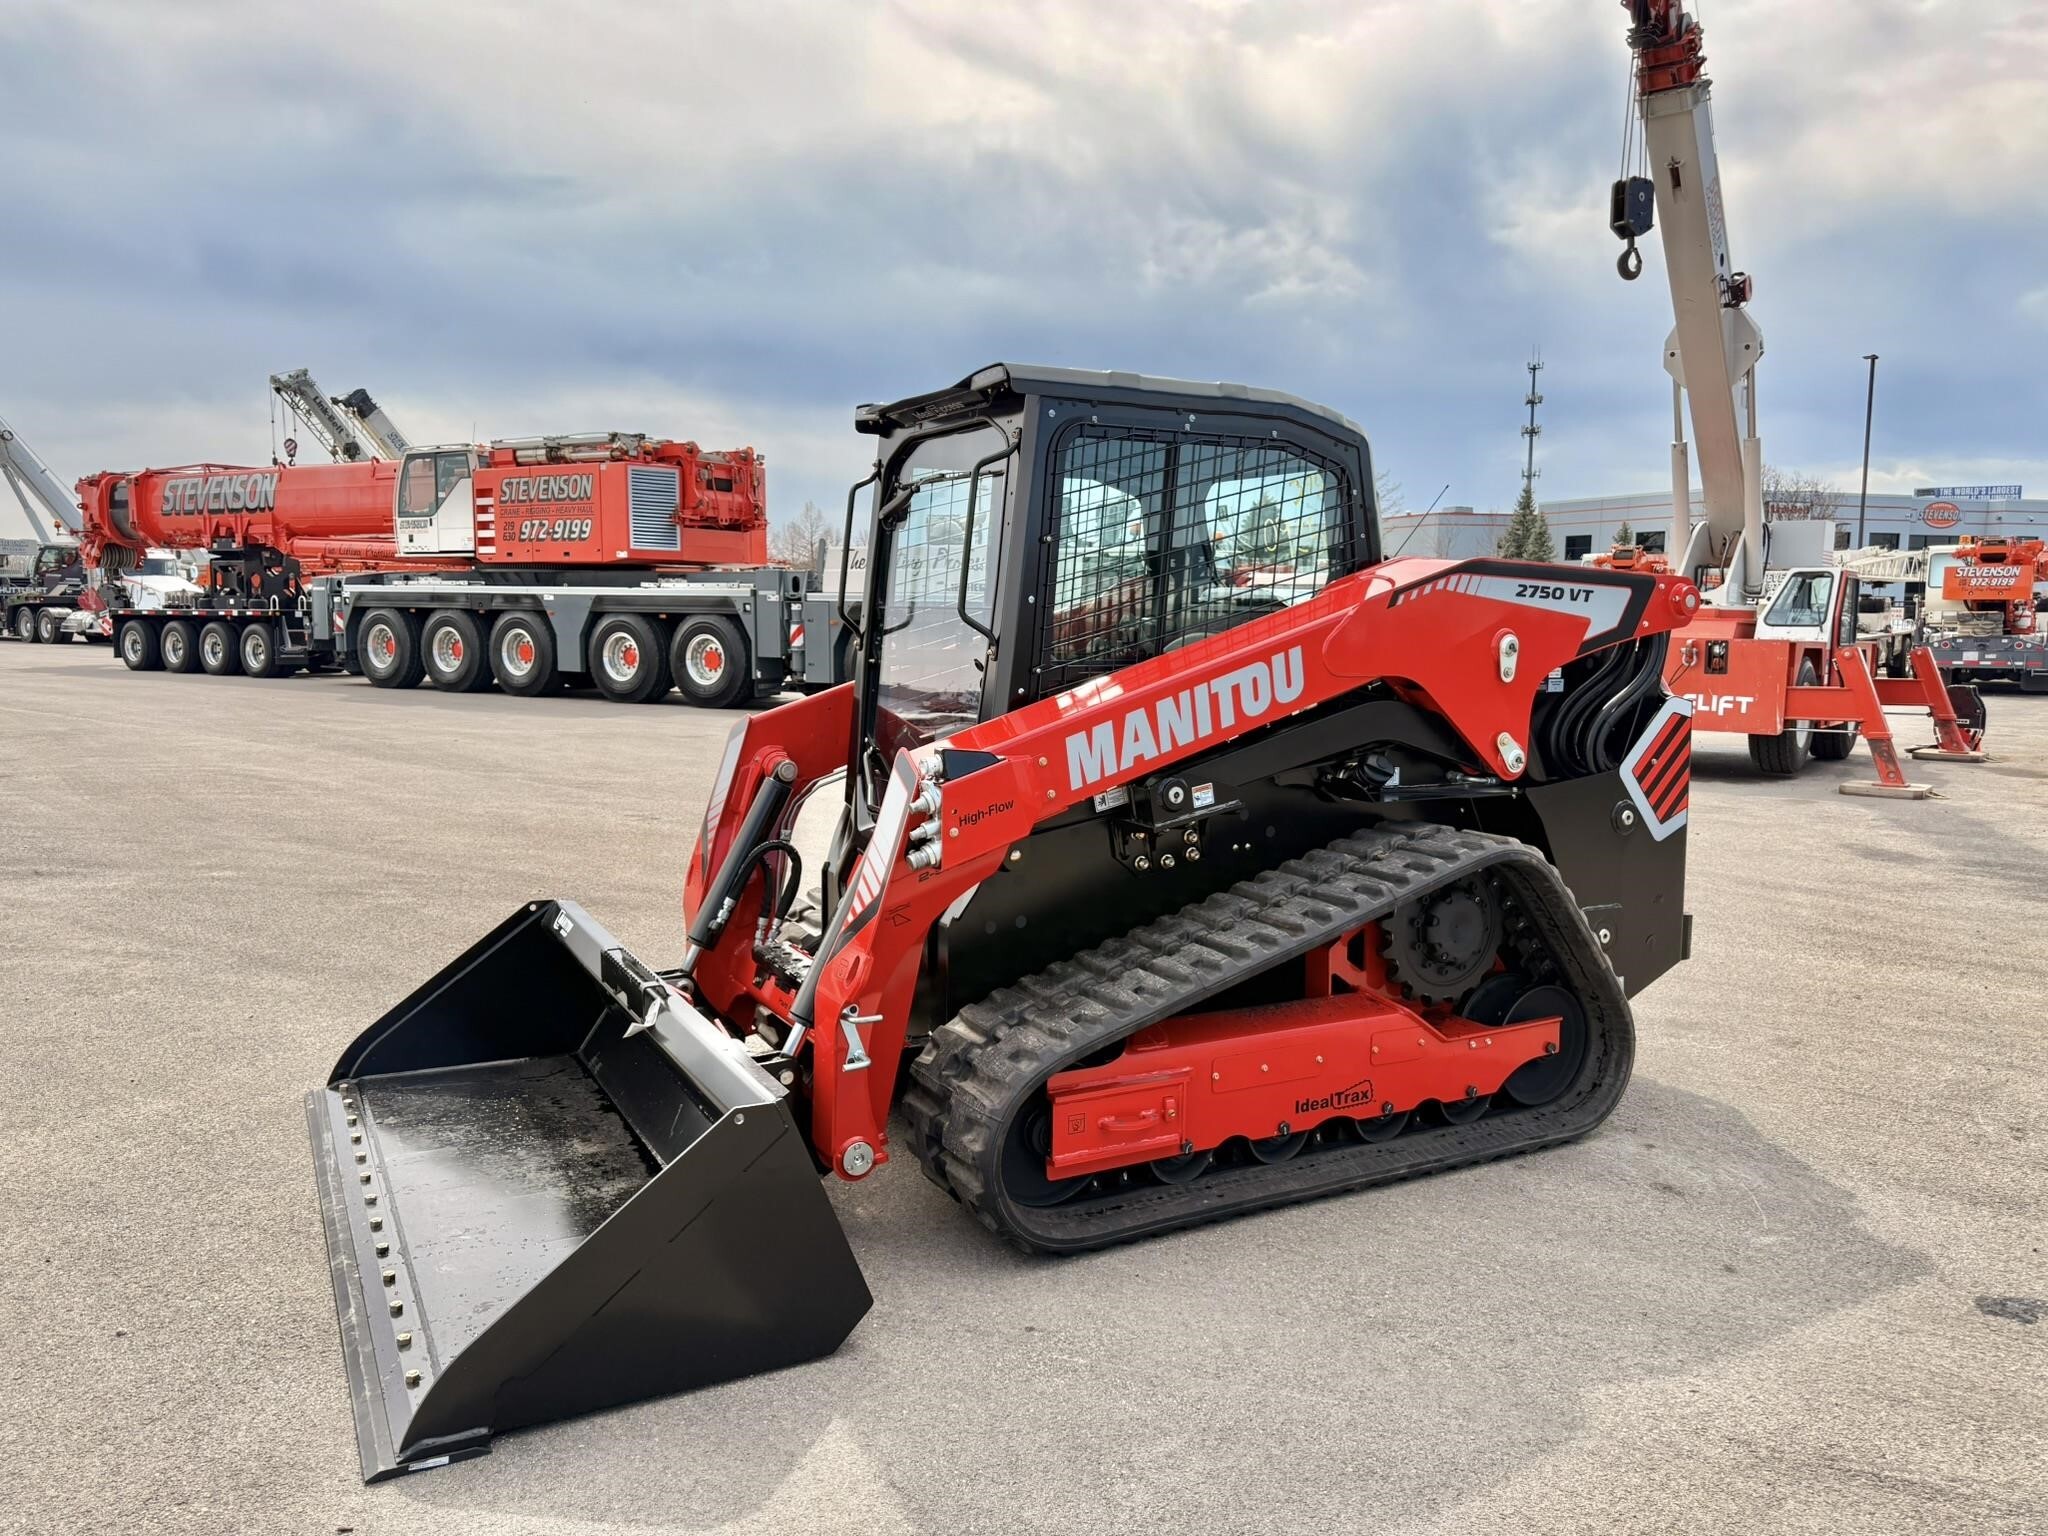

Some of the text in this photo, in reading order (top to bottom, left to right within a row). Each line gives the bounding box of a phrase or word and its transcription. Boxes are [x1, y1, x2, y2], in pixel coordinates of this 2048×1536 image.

[162, 473, 278, 515] STEVENSON
[499, 474, 593, 504] STEVENSON
[1939, 486, 2019, 496] THE WORLD'S LARGEST
[500, 508, 520, 516] CRANE
[556, 506, 576, 514] HEAVY
[519, 518, 592, 542] 972-9199
[1955, 566, 2021, 577] STEVENSON
[1515, 584, 1595, 602] 2750 VT
[1065, 645, 1305, 791] MANITOU
[959, 800, 1014, 827] High-Flow
[1295, 1089, 1370, 1114] IdealTrax
